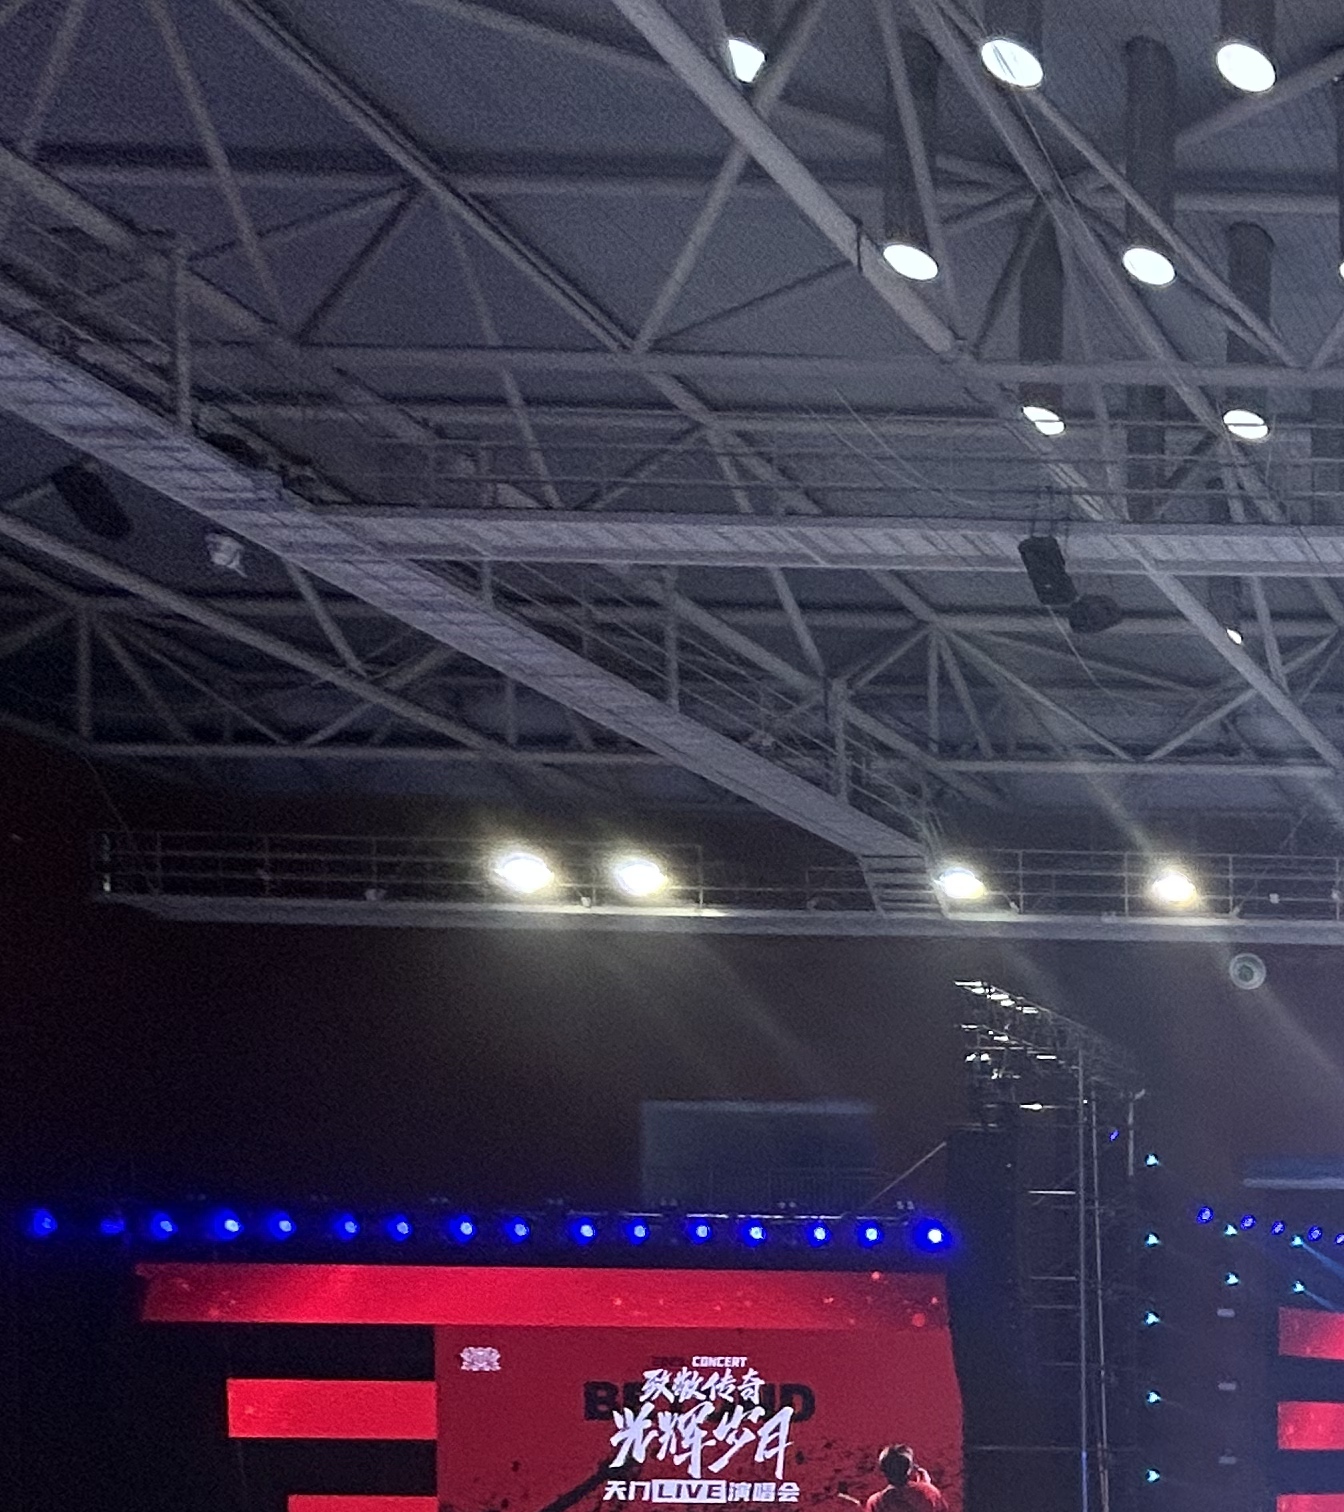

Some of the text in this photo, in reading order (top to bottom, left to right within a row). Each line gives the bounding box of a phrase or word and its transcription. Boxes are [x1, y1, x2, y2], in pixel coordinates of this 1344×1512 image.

[691, 1356, 748, 1368] CONCERT
[639, 1366, 766, 1404] 致敬传奇
[609, 1402, 795, 1480] 光辉岁月
[602, 1479, 801, 1503] 天门LIVE演唱会
